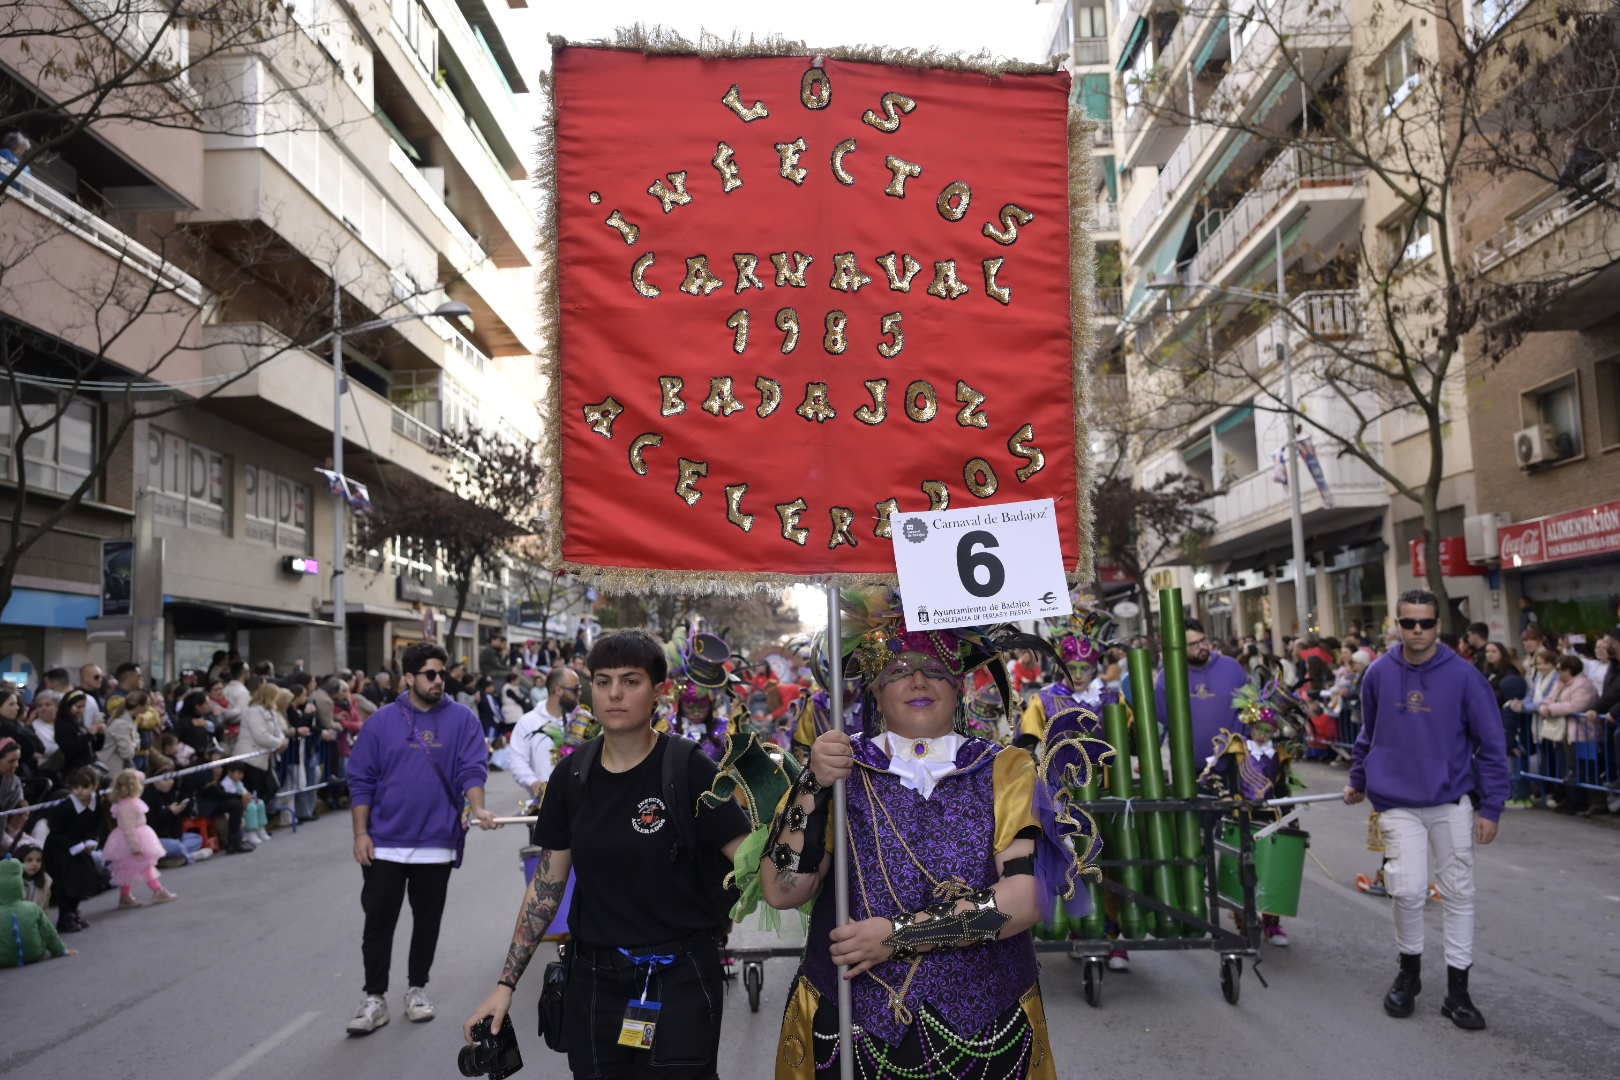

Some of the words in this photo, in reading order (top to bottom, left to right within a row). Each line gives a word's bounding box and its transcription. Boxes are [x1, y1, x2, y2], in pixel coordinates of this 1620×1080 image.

[721, 66, 919, 134] LOS
[631, 250, 1013, 305] CARNAVAL
[727, 307, 906, 360] 1985
[658, 376, 991, 430] BADAJOZ
[932, 514, 981, 530] Carnaval
[984, 513, 999, 525] de
[1001, 509, 1047, 523] Badajoz
[956, 530, 1006, 598] 6
[933, 606, 987, 618] Ayuntamiento
[989, 603, 999, 612] de
[1001, 601, 1031, 611] Badajoz
